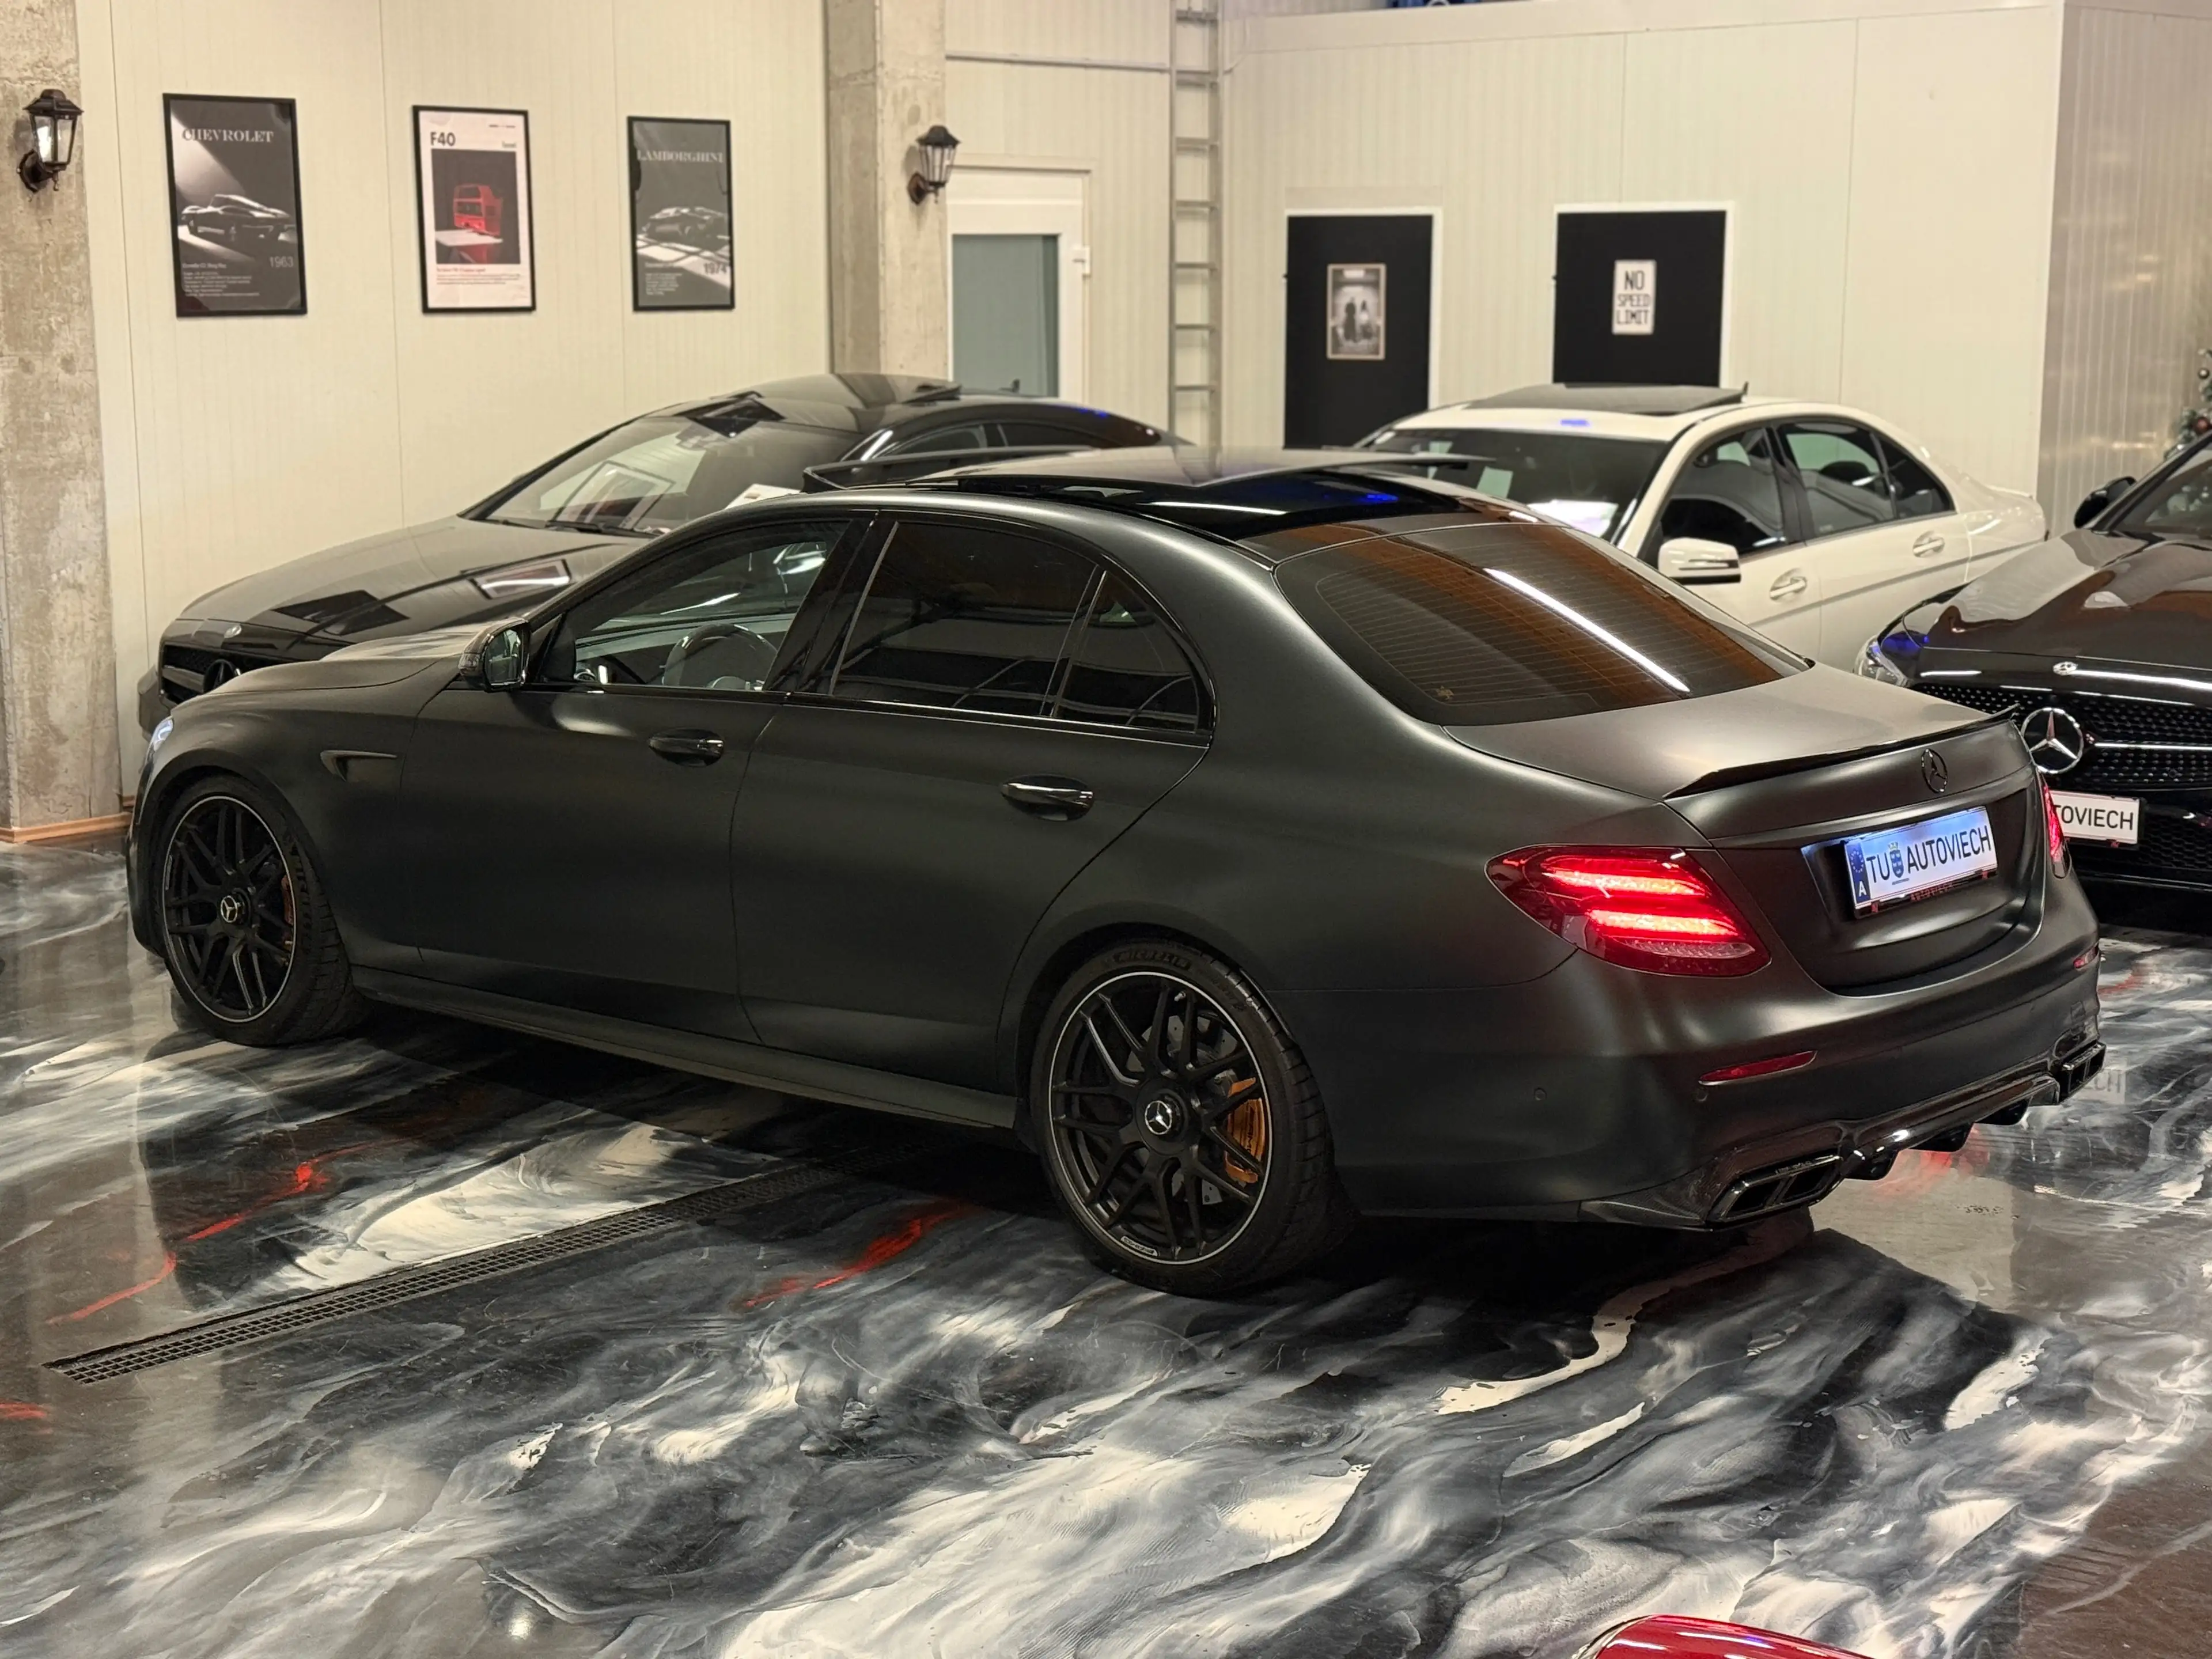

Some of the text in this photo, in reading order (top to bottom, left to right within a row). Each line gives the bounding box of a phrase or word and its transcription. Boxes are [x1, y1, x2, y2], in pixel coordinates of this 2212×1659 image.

[182, 128, 274, 143] CHEVROLET
[430, 131, 456, 146] F40
[637, 150, 724, 164] LAMBORGHINI
[269, 256, 294, 268] 1963
[1624, 270, 1645, 291] NO
[1618, 293, 1652, 307] SPEED
[1616, 309, 1649, 325] LIMIT
[1866, 825, 1991, 883] TU AUTOVIECH
[1858, 881, 1867, 897] A
